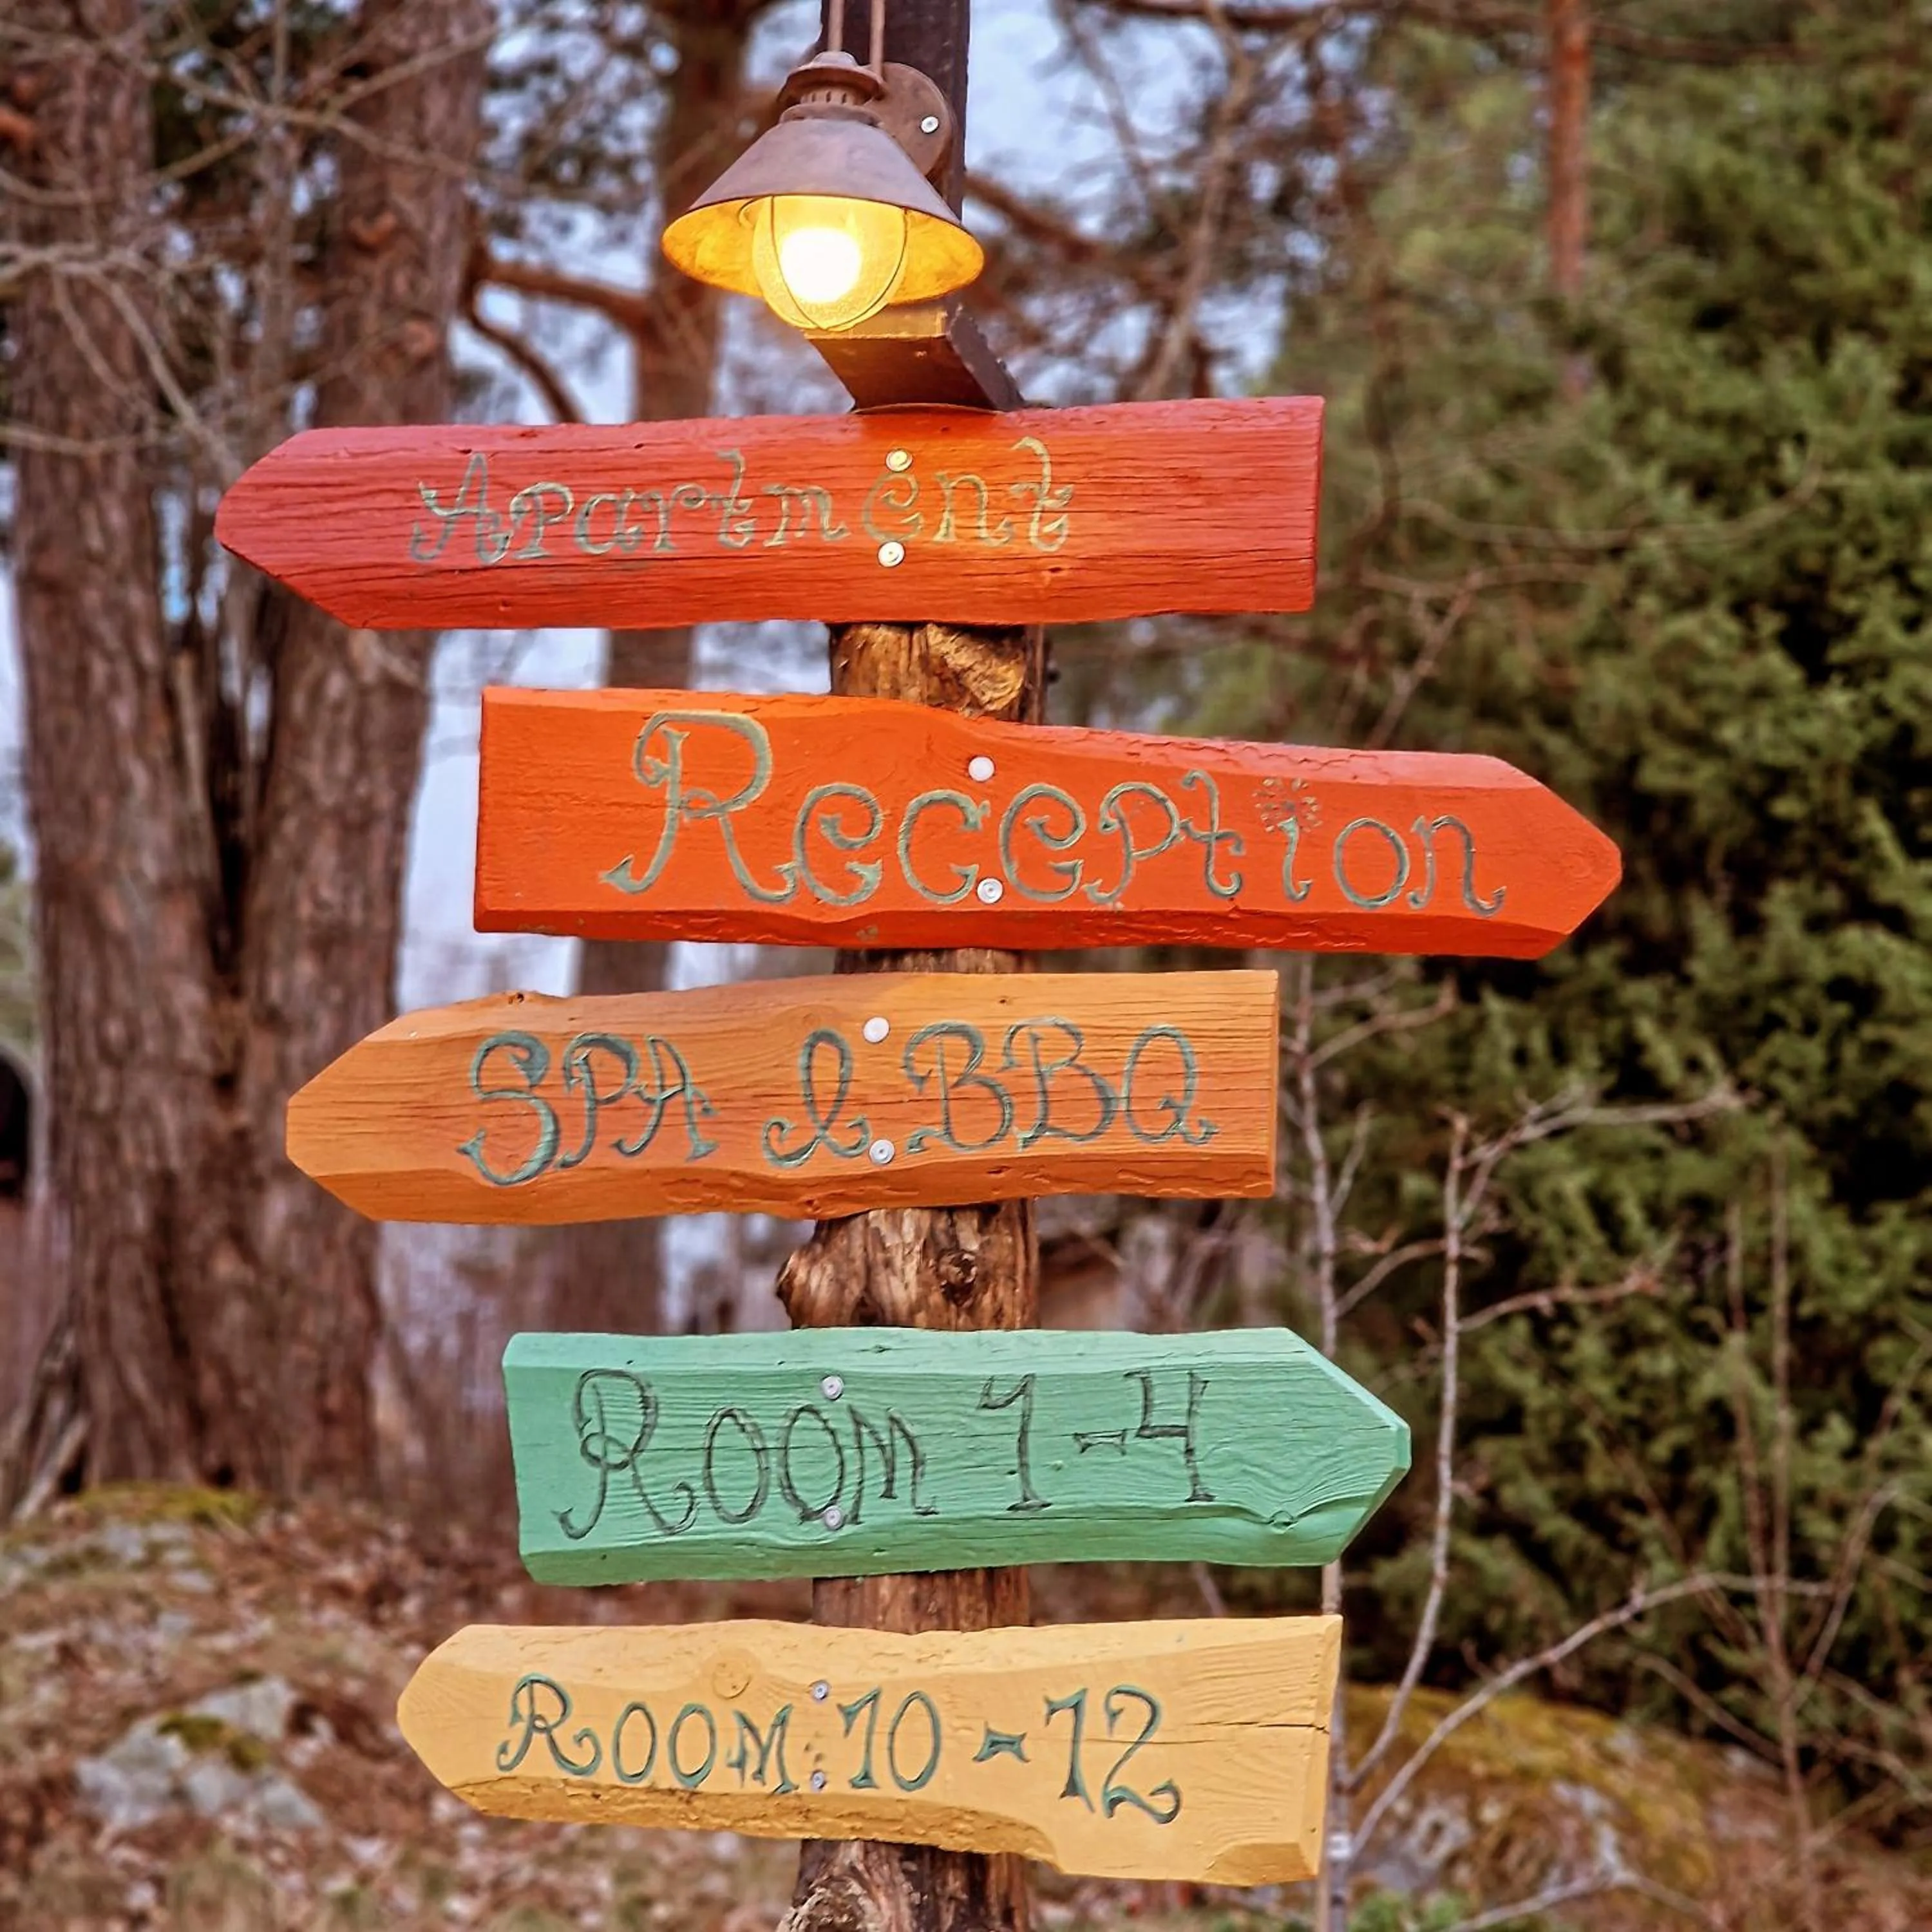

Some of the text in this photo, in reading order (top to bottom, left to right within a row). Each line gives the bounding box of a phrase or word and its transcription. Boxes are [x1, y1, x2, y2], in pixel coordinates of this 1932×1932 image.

[598, 710, 1506, 917] Reception
[456, 1030, 719, 1186] SPA
[902, 1016, 1220, 1154] BBQ
[497, 1673, 799, 1794] ROOM
